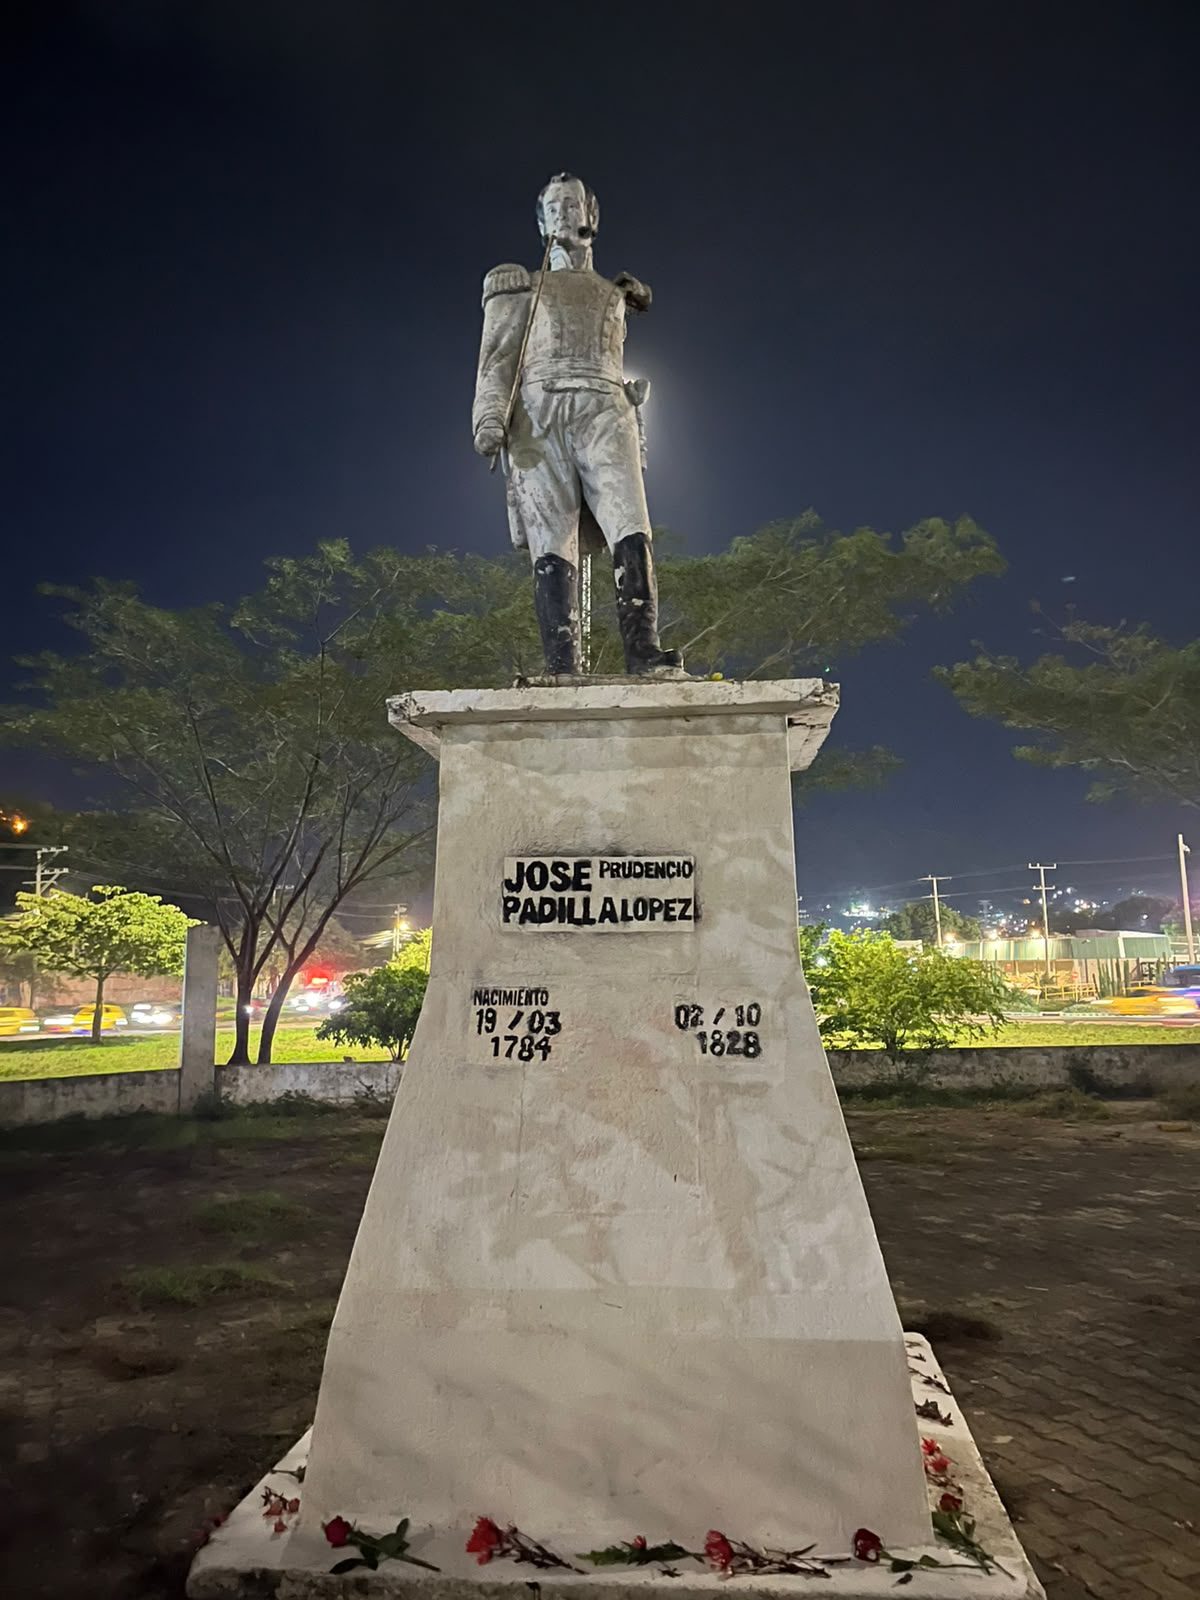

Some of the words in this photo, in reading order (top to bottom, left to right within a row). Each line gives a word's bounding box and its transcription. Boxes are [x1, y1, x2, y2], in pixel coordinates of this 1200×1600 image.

[504, 861, 592, 892] JOSE
[599, 860, 693, 879] PRUDENCIO
[503, 896, 618, 925] PADILLA
[620, 898, 692, 922] LOPEZ
[473, 989, 549, 1006] NACIMIENTO
[491, 1035, 552, 1062] 1784
[696, 1030, 762, 1058] 1828
